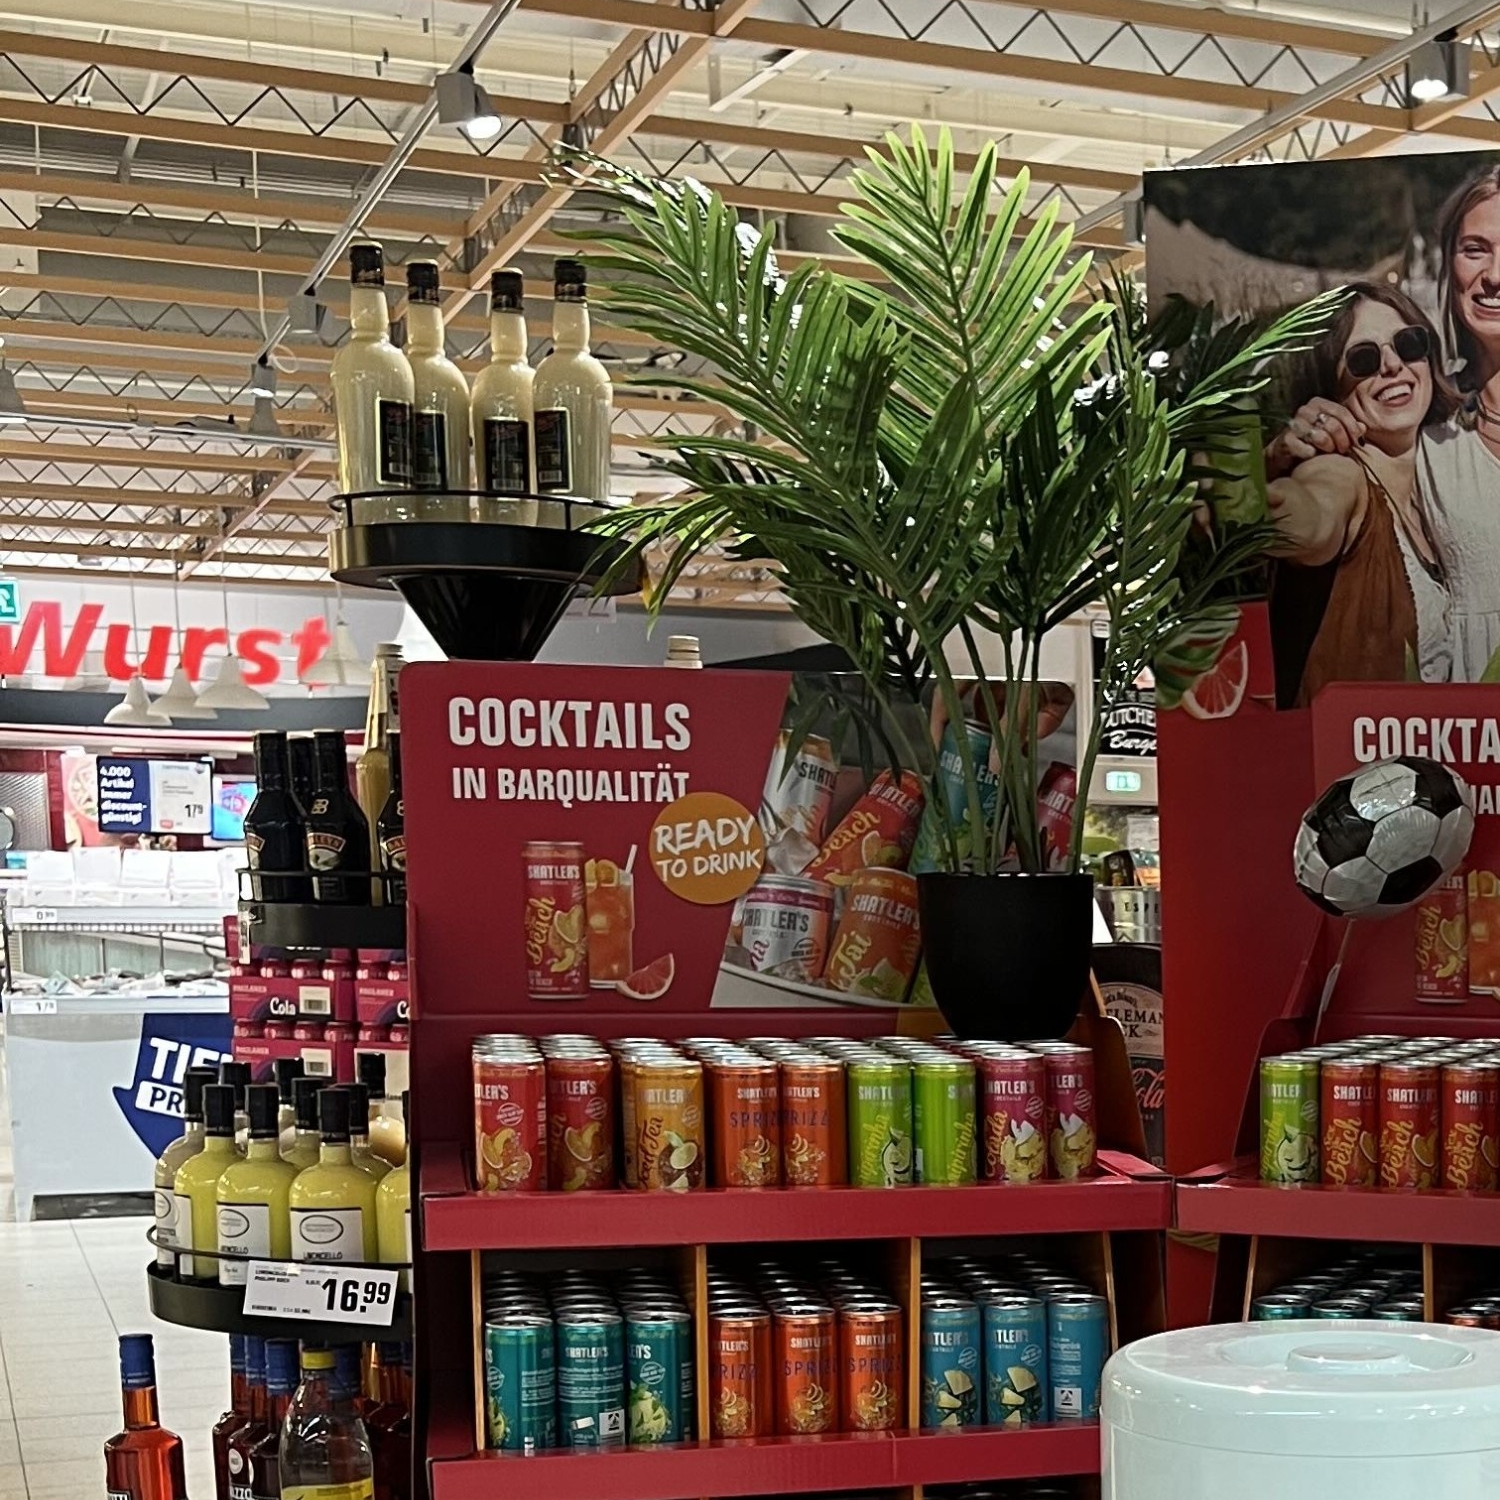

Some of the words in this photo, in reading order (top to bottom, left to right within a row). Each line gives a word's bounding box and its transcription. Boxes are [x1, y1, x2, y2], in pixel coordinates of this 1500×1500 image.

[448, 697, 691, 751] COCKTAILS
[452, 767, 487, 799] IN
[498, 763, 690, 808] BARQUALITÄT
[655, 813, 756, 855] READY
[656, 859, 688, 882] TO
[692, 848, 762, 877] DRINK
[270, 997, 296, 1016] Cola
[321, 1279, 392, 1313] 16.99
